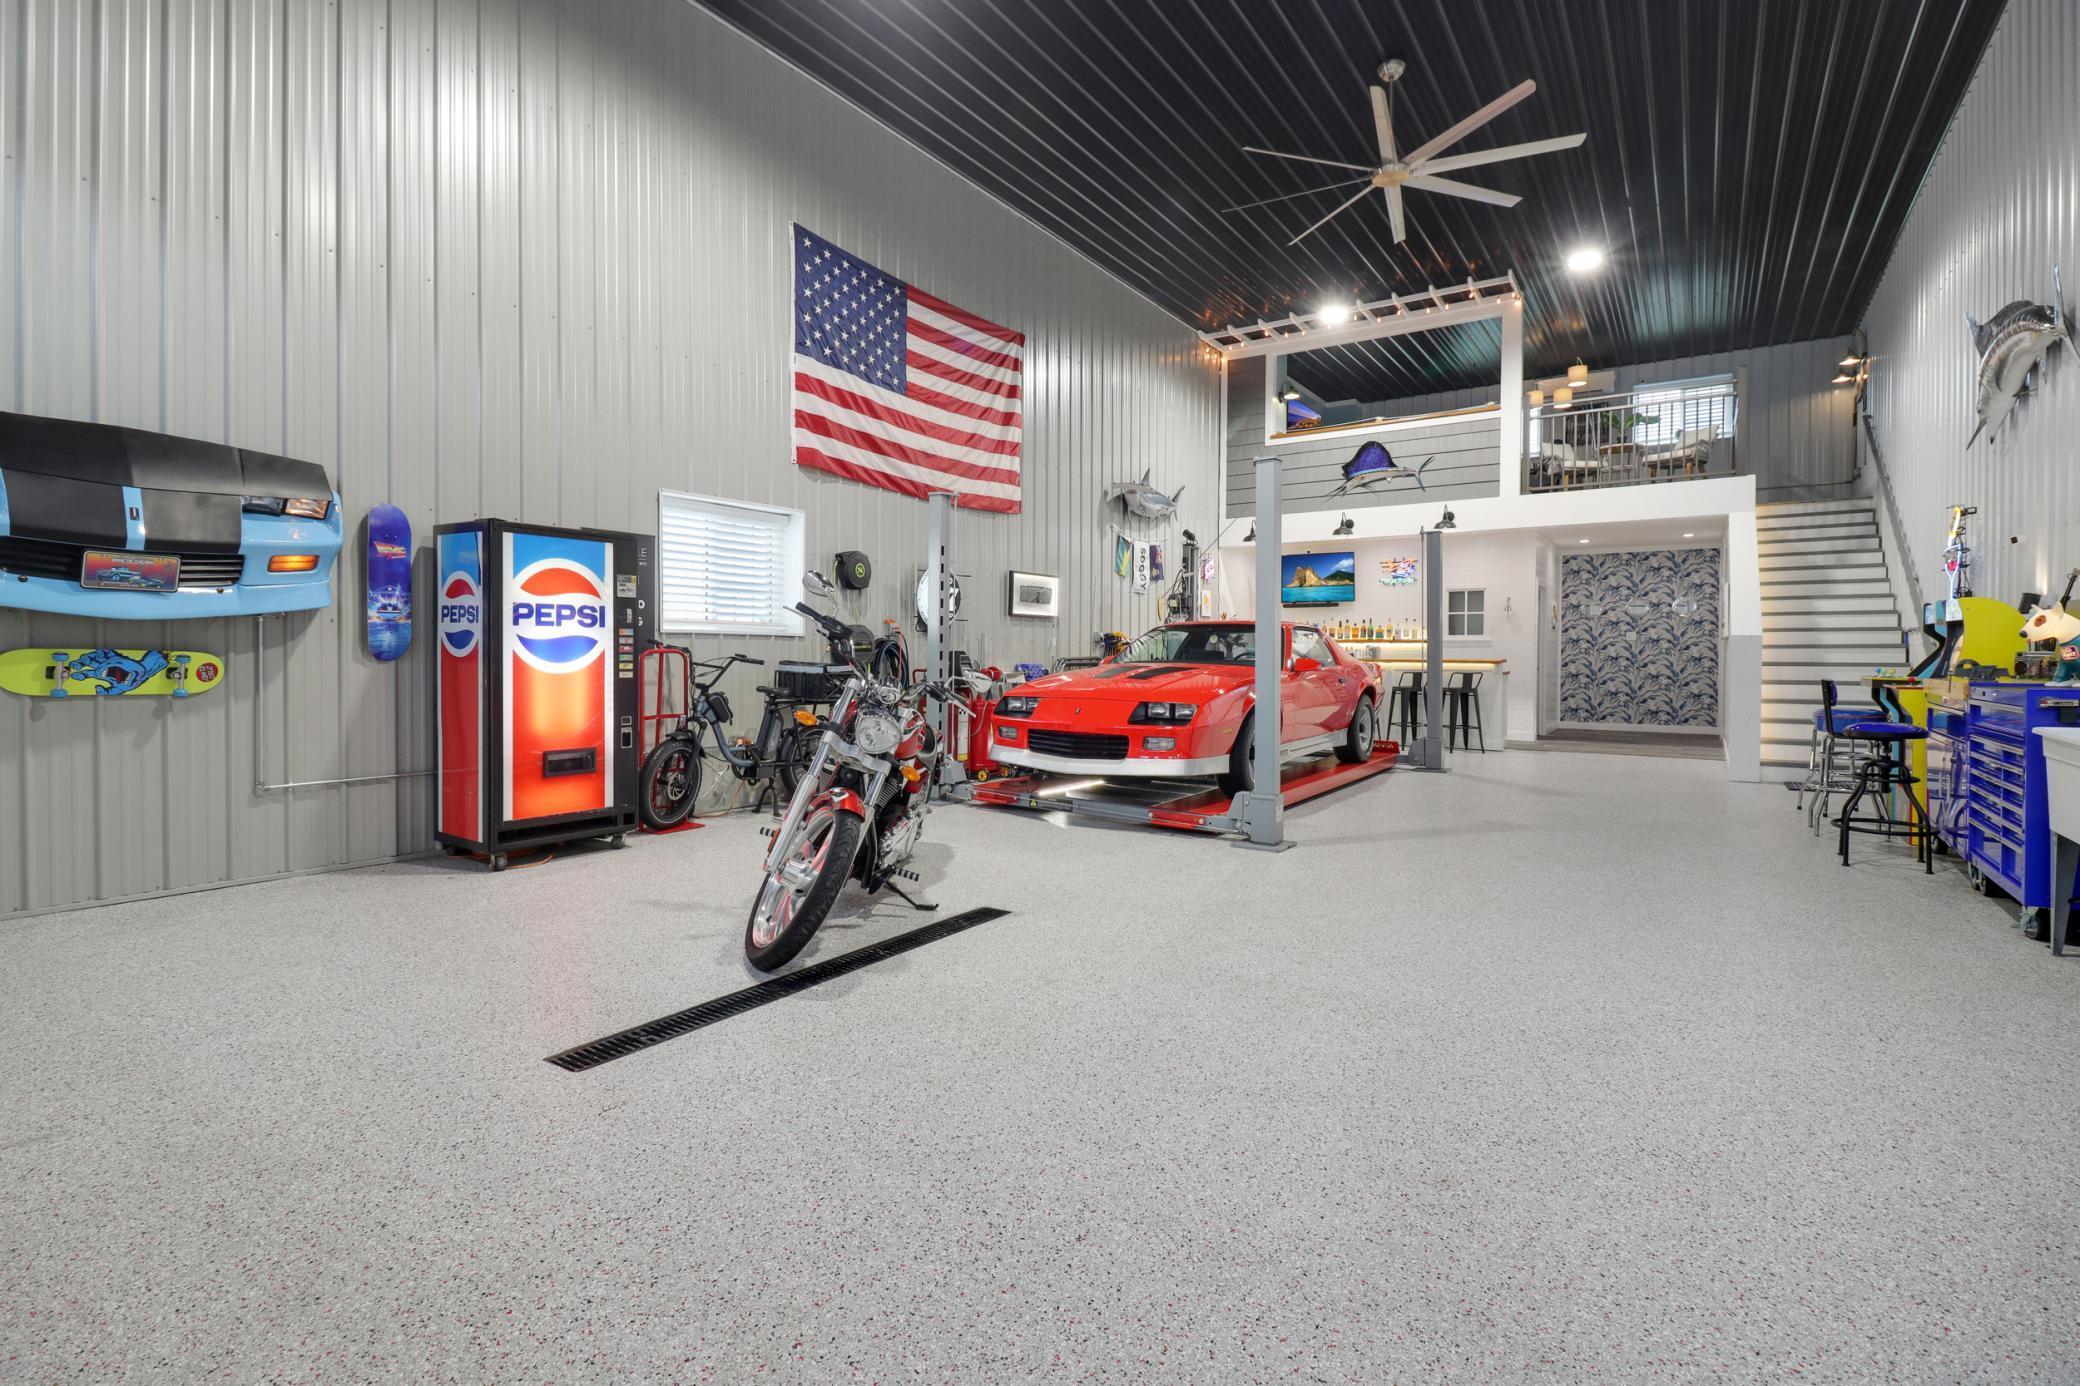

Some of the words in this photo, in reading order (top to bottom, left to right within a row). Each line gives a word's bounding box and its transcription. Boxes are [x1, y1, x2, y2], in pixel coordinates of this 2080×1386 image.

[1138, 547, 1147, 590] SOGGY
[441, 604, 479, 624] PEPSI
[512, 602, 606, 628] PEPSI
